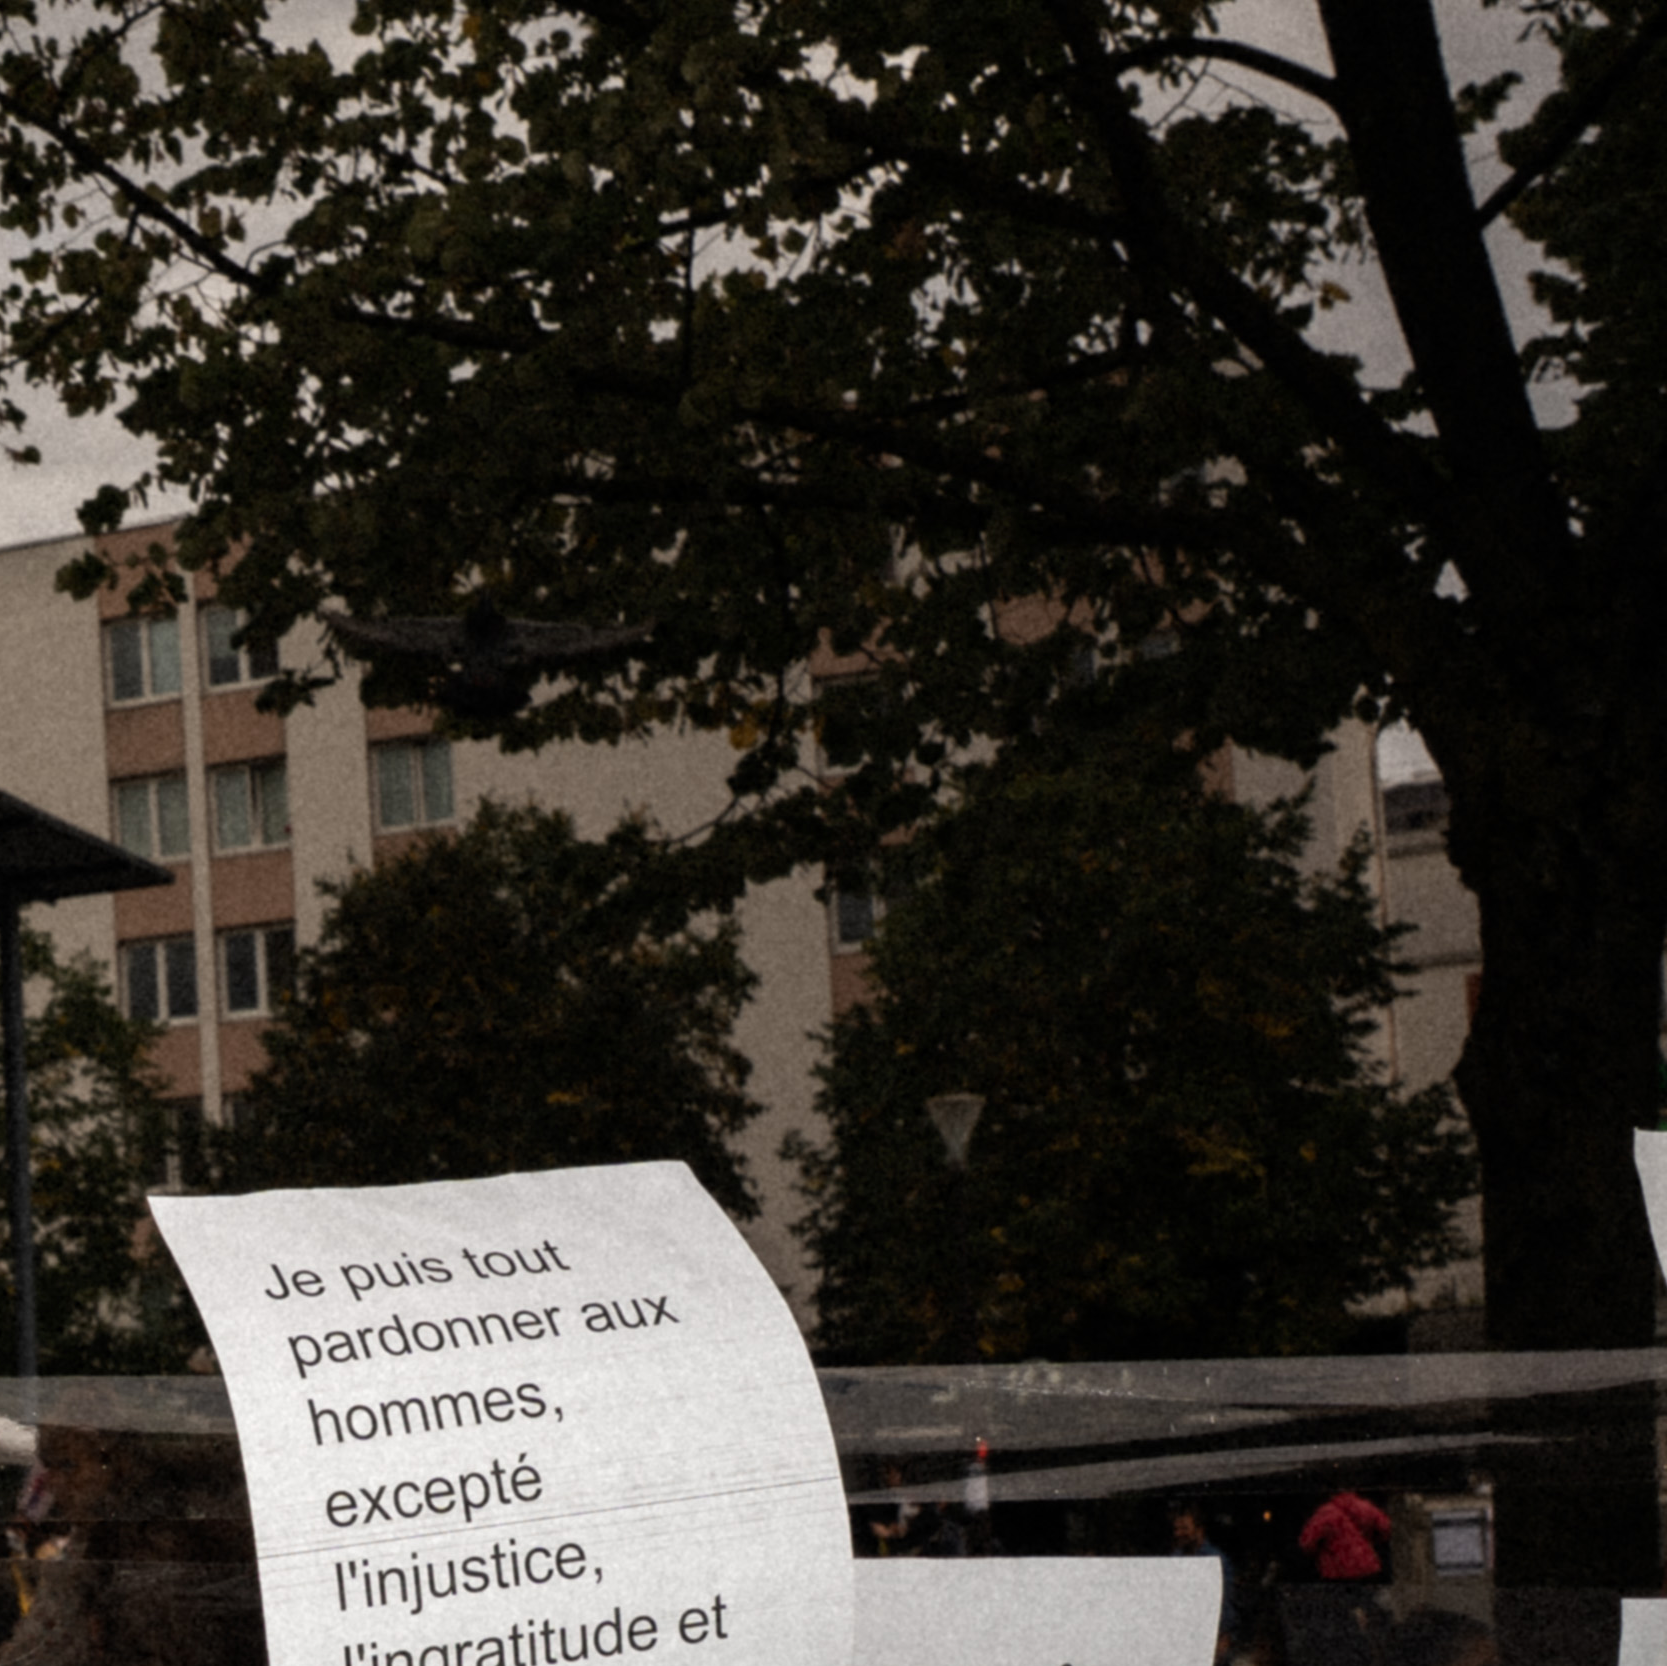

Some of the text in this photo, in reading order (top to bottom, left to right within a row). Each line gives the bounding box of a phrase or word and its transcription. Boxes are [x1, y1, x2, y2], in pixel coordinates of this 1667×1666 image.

[266, 1241, 570, 1301] Je puis tout
[289, 1297, 678, 1378] pardonner aux
[308, 1384, 562, 1445] hommes,
[327, 1453, 542, 1527] excepté
[336, 1539, 602, 1614] l'injustice,
[679, 1595, 727, 1643] et
